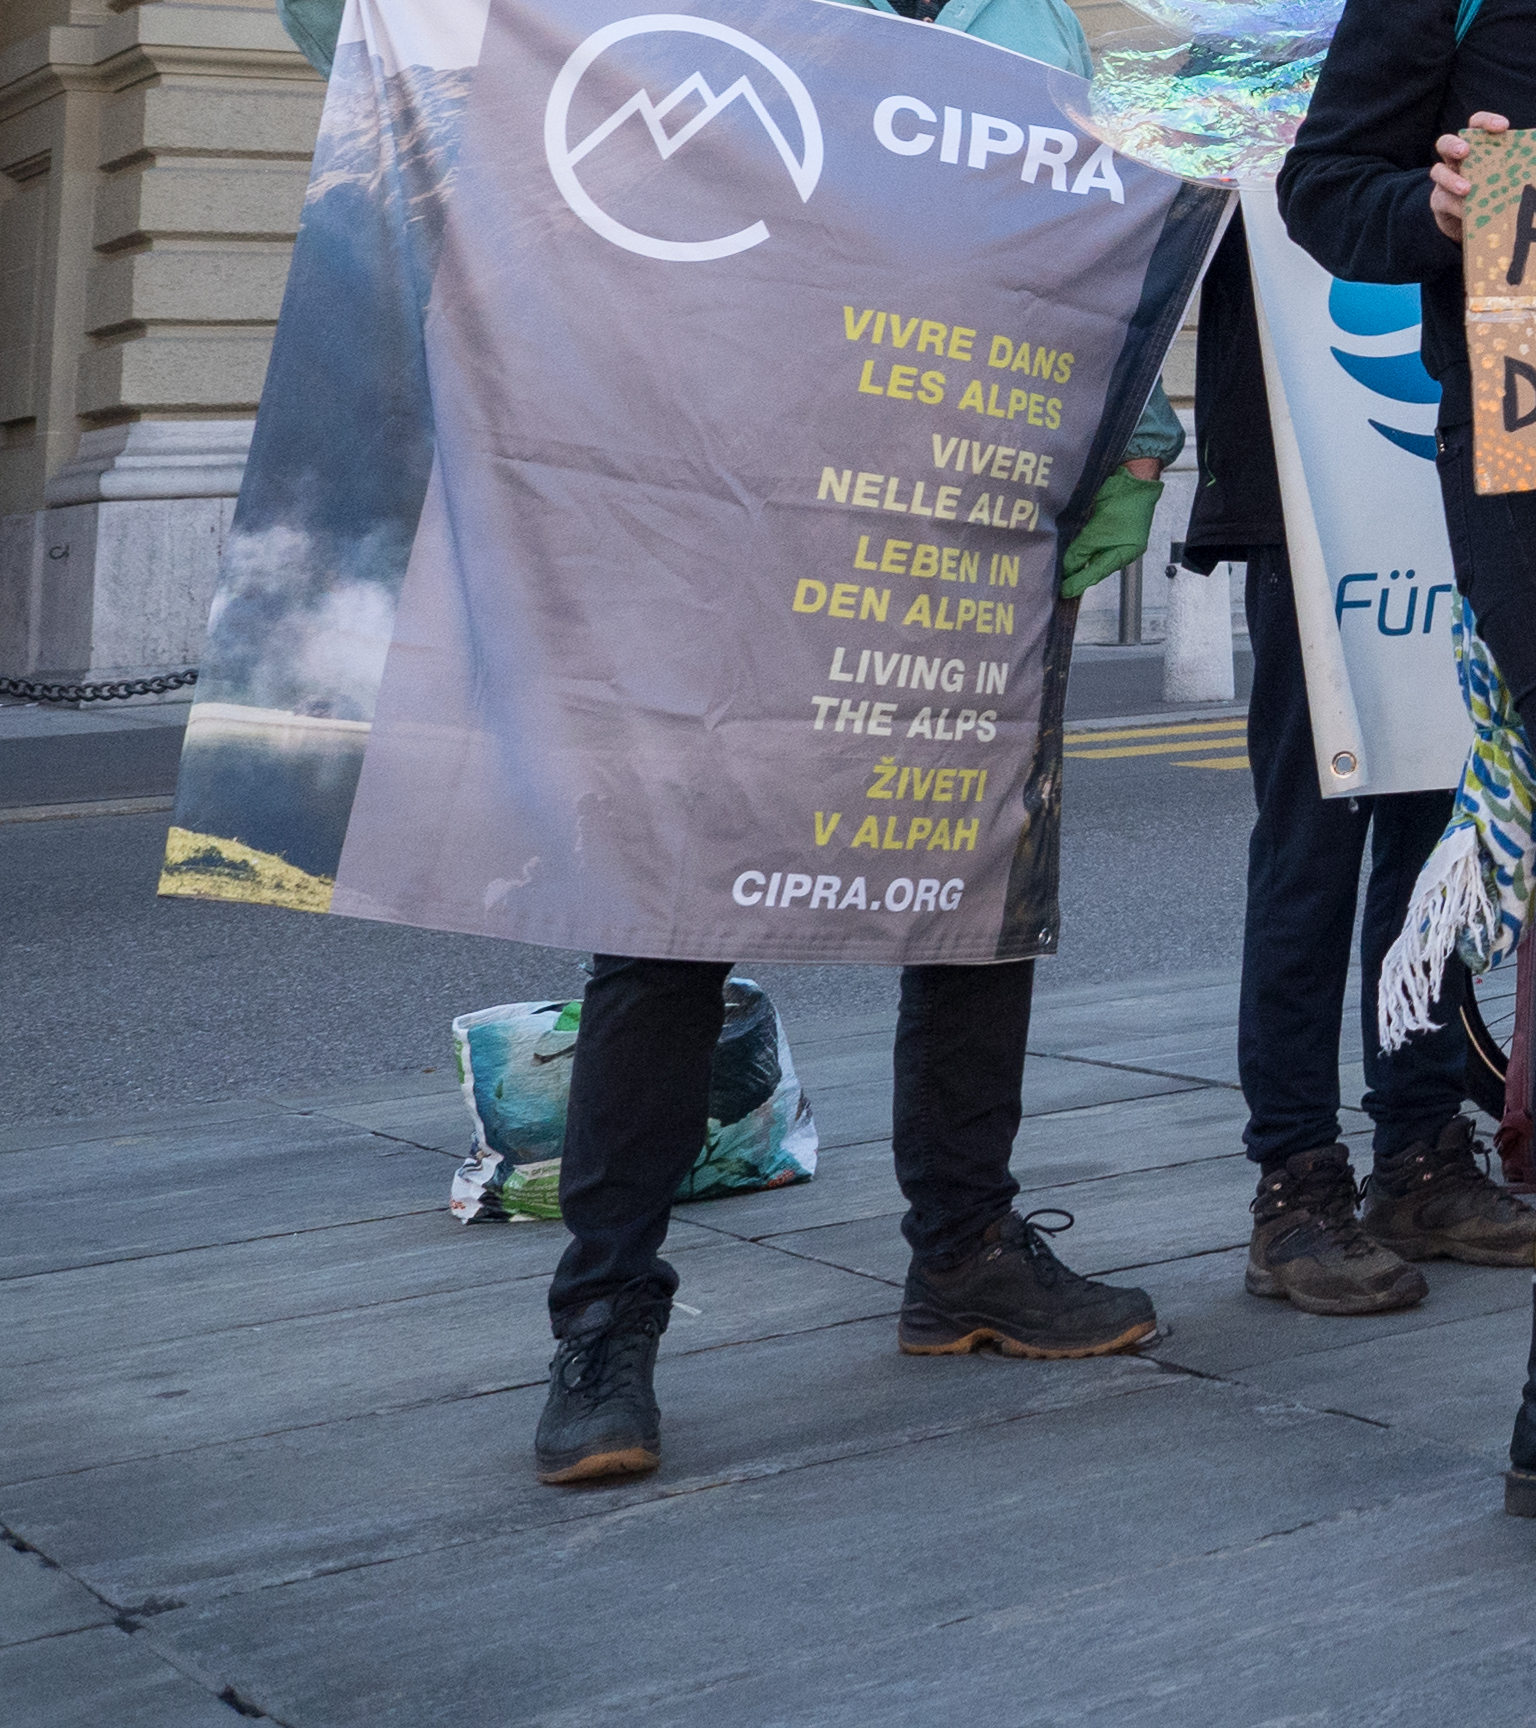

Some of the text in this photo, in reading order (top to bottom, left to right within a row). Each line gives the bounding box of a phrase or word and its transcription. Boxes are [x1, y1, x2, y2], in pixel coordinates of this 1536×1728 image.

[873, 95, 1125, 205] CIPRA
[843, 306, 1075, 384] VIVRE DANS
[858, 359, 1063, 430] LES ALPES
[932, 433, 1054, 488] VIVERE
[816, 466, 1039, 532] NELLE ALPI
[853, 535, 1020, 588] LEBEN IN
[791, 578, 1015, 635] DEN ALPEN
[1334, 569, 1453, 636] Für
[828, 646, 1010, 695] LIVING IN
[811, 695, 998, 743] THE ALPS
[866, 756, 989, 803] ŽIVETI
[814, 811, 981, 852] V ALPAH
[731, 870, 966, 913] CIPRA.ORG
